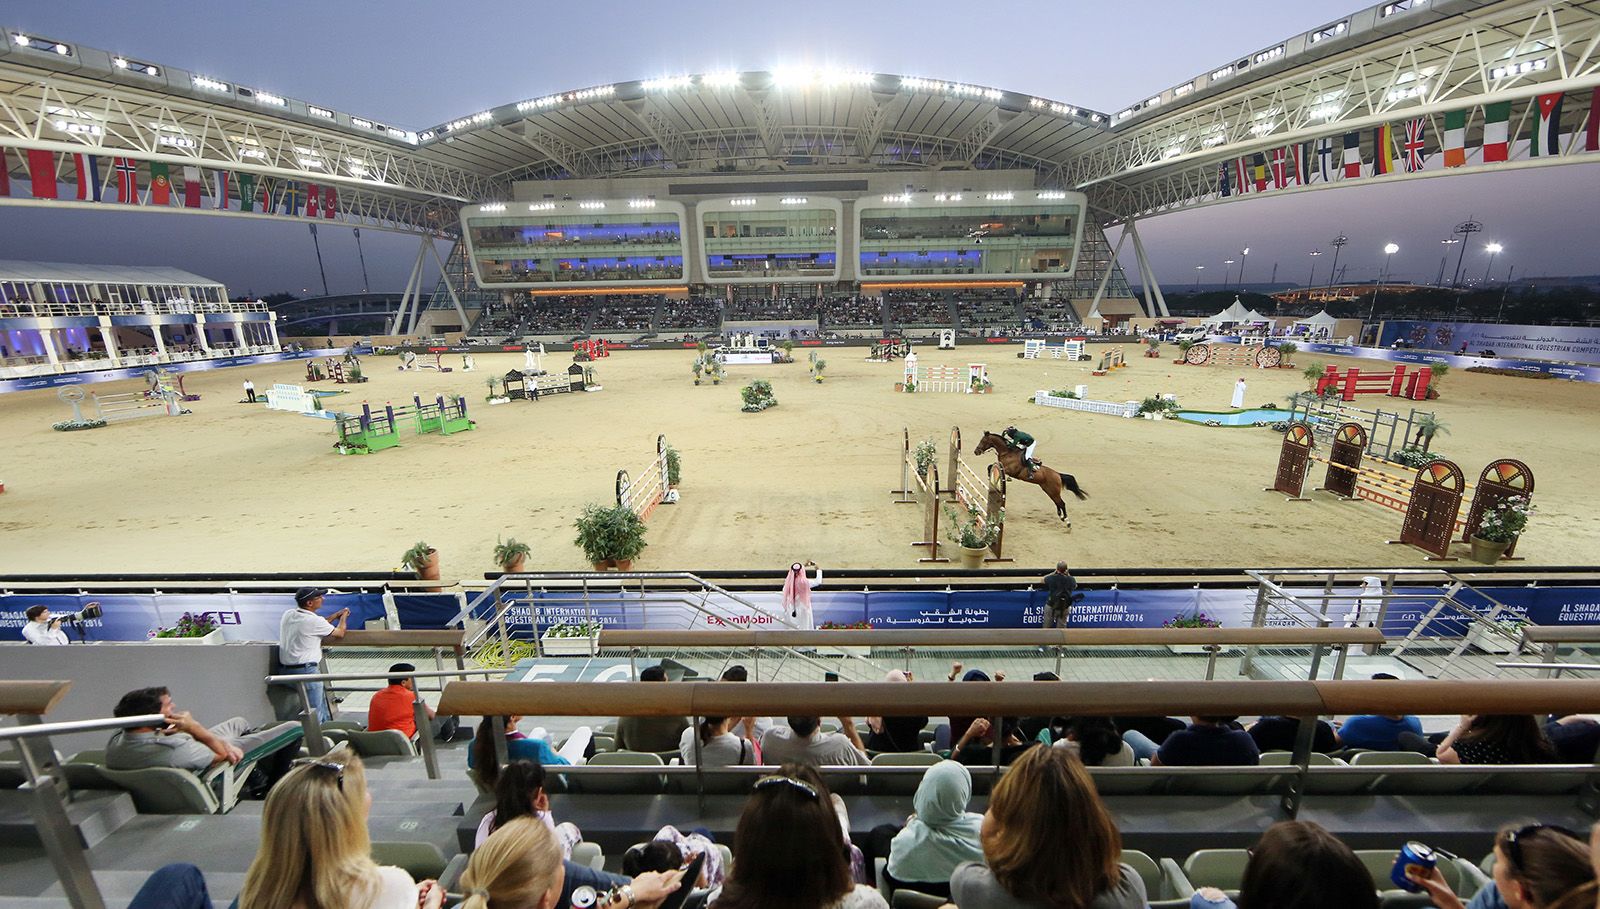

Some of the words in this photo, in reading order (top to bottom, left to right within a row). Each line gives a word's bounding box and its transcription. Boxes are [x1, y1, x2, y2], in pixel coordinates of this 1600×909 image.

[1495, 342, 1534, 350] INTERNATIONAL
[1535, 344, 1570, 352] EQUESTRIAN
[512, 608, 541, 616] SHAQB
[543, 608, 599, 616] INTERNATIOAL
[919, 608, 963, 616] الشقب
[964, 607, 989, 616] بطولة
[1023, 607, 1034, 615] AL
[1068, 605, 1128, 614] INTERNATIONAL
[1561, 604, 1571, 612] AL
[504, 616, 546, 624] QUESTRAN
[548, 616, 597, 624] COMPETITIN
[599, 616, 618, 624] 2016
[886, 616, 945, 624] للفروسية
[947, 616, 989, 624] الدولية
[1072, 614, 1123, 623] COMPETITION
[1125, 613, 1144, 622] 2016
